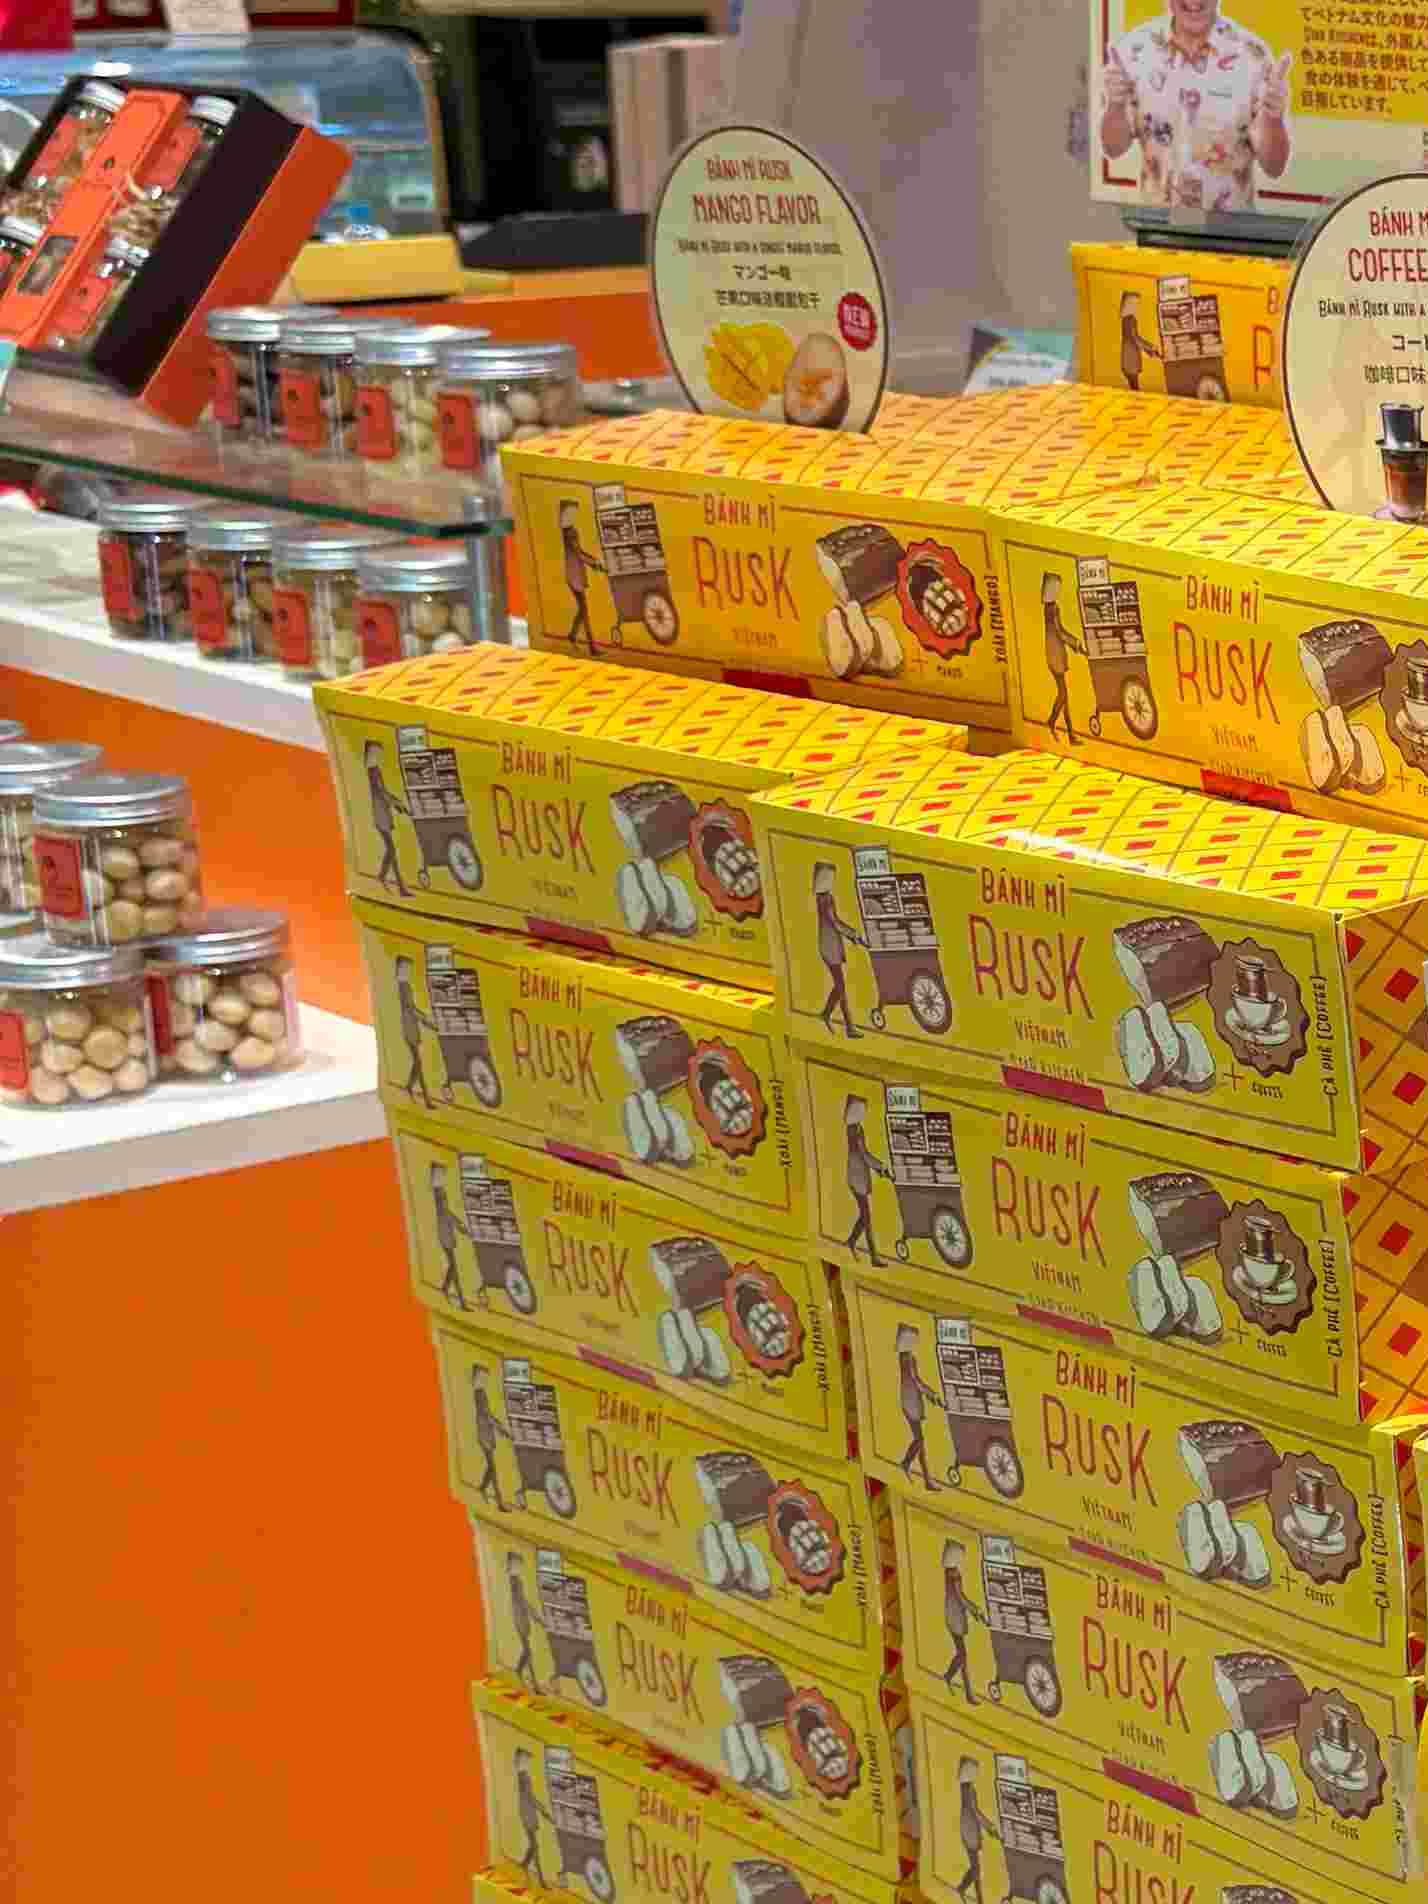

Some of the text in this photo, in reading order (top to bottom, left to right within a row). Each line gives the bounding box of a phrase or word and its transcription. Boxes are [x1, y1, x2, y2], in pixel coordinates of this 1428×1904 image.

[693, 192, 821, 225] MANGO FLAVOR
[1369, 206, 1414, 237] BÁNH
[1319, 298, 1345, 318] BÁNH
[1362, 298, 1389, 319] RUSK
[1393, 302, 1416, 318] WITH
[1419, 302, 1426, 318] A
[981, 866, 1066, 917] BÁNH MÌ
[968, 912, 1094, 1020] RUSK
